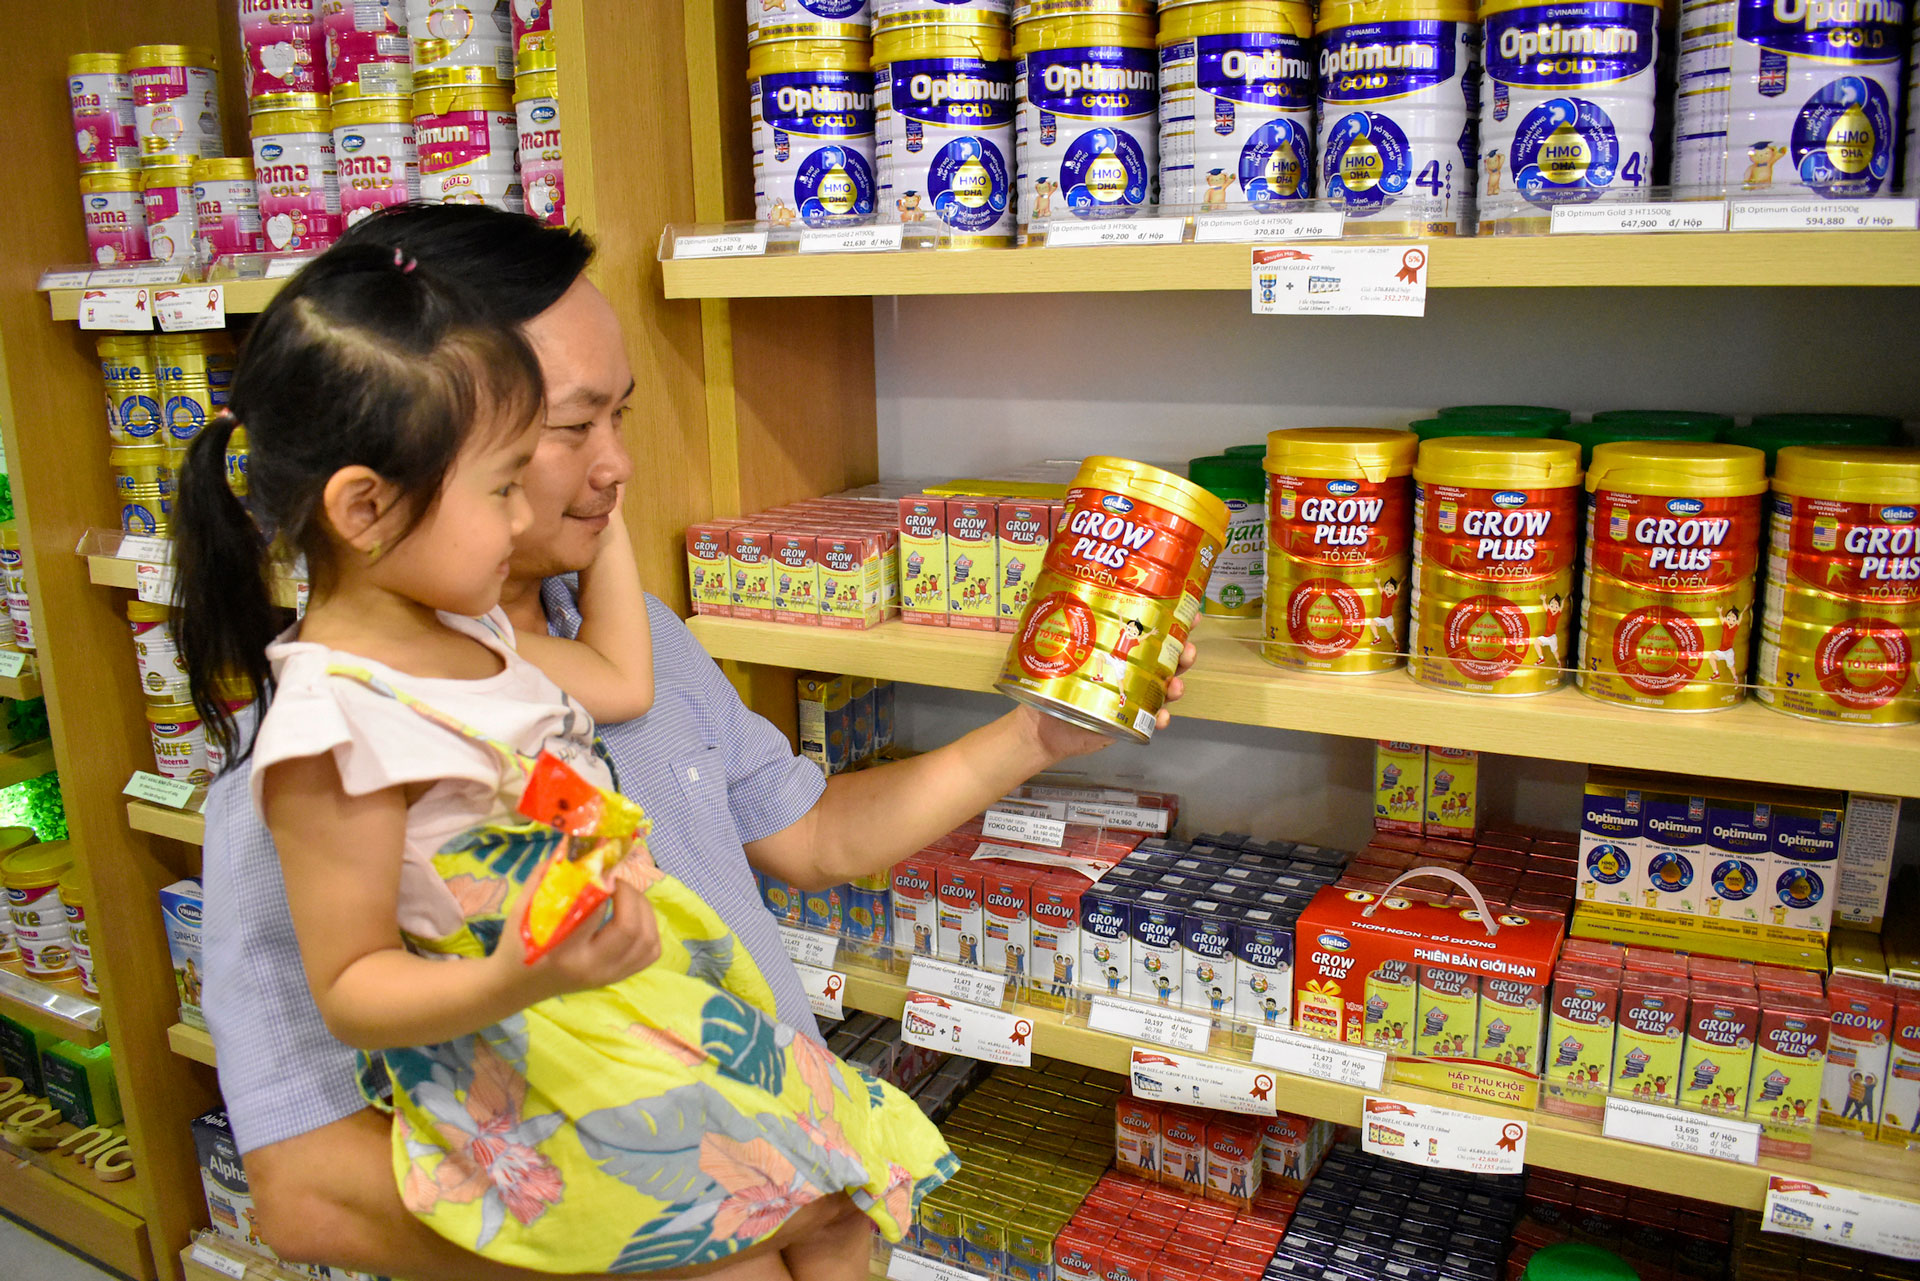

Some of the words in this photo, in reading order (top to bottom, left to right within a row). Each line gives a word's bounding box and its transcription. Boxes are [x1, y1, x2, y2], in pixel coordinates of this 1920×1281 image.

[1500, 24, 1638, 65] Optimum
[1319, 42, 1433, 76] Optimum
[1537, 59, 1597, 75] GOLD
[1340, 73, 1388, 91] GOLD
[1082, 94, 1130, 107] GOLD
[948, 103, 992, 117] GOLD
[812, 114, 856, 127] GOLD
[1837, 131, 1869, 144] HMO
[1546, 146, 1582, 158] HMO
[1841, 149, 1863, 158] DHA
[1345, 156, 1375, 168] HMO
[1551, 162, 1576, 171] DHA
[960, 176, 986, 186] HMO
[1092, 169, 1121, 179] HMO
[1350, 171, 1370, 179] DHA
[1416, 160, 1444, 196] 4
[352, 177, 393, 190] GOLD
[444, 175, 470, 189] GOLD
[824, 184, 851, 192] HMO
[270, 184, 311, 197] GOLD
[1568, 209, 1604, 219] Optimum
[1607, 208, 1626, 217] Gold
[1628, 208, 1633, 216] 3
[1635, 207, 1671, 218] HT1500g
[1750, 206, 1787, 216] Optimum
[1790, 205, 1810, 213] Gold
[1820, 205, 1859, 214] HT1500g
[1621, 219, 1658, 229] 647,900
[1683, 218, 1703, 229] Hộp
[1806, 216, 1845, 226] 594,880
[1872, 215, 1893, 226] Hộp
[1100, 233, 1130, 241] 409,200
[1149, 232, 1164, 241] Hộp
[1254, 227, 1285, 236] 370,810
[1306, 226, 1323, 236] Hộp
[712, 244, 733, 252] 426,140
[843, 239, 866, 247] 421,630
[880, 239, 893, 247] Hộp
[1408, 255, 1420, 263] 5%
[103, 362, 141, 381] Sure
[1301, 498, 1384, 523] GROW
[905, 515, 937, 528] GROW
[953, 517, 987, 530] GROW
[1006, 520, 1040, 533] GROW
[1463, 510, 1551, 536] GROW
[912, 525, 932, 536] PLUS
[959, 528, 982, 538] PLUS
[1011, 530, 1035, 542] PLUS
[1070, 510, 1155, 550] GROW
[1314, 524, 1368, 546] PLUS
[1634, 517, 1730, 546] GROW
[694, 542, 718, 552] GROW
[736, 545, 761, 555] GROW
[780, 548, 806, 559] GROW
[1071, 536, 1129, 569] PLUS
[1476, 538, 1535, 561] PLUS
[699, 550, 715, 559] PLUS
[741, 553, 758, 563] PLUS
[785, 556, 803, 566] PLUS
[825, 552, 853, 563] GROW
[1649, 548, 1712, 571] PLUS
[831, 560, 848, 570] PLUS
[152, 737, 192, 756] Sure
[1587, 811, 1638, 827] Optimum
[988, 822, 1005, 833] YOKO
[1007, 824, 1025, 833] GOLD
[1649, 819, 1702, 834] Optimum
[1713, 826, 1767, 842] Optimum
[1779, 833, 1833, 848] Optimum
[895, 876, 930, 891] GROW
[941, 884, 976, 900] GROW
[987, 894, 1023, 910] GROW
[1035, 902, 1074, 919] GROW
[1088, 913, 1123, 928] GROW
[1093, 923, 1118, 936] PLUS
[1139, 922, 1176, 936] GROW
[1351, 921, 1385, 932] THƠM
[1387, 927, 1421, 938] NGON
[1431, 934, 1449, 942] BỔ
[1450, 937, 1496, 949] DƯỠNG
[1145, 933, 1170, 946] PLUS
[1191, 931, 1229, 947] GROW
[1198, 943, 1223, 956] PLUS
[1245, 942, 1283, 958] GROW
[1251, 953, 1277, 966] PLUS
[1311, 952, 1355, 970] GROW
[1414, 948, 1450, 963] PHIÊN
[1451, 953, 1478, 967] BẢN
[1480, 959, 1506, 971] GIỚI
[1508, 964, 1536, 978] HẠN
[1318, 965, 1347, 980] PLUS
[1427, 968, 1468, 985] GROW
[953, 978, 971, 986] 11,473
[1433, 980, 1460, 994] PLUS
[1489, 979, 1533, 995] GROW
[1496, 990, 1525, 1004] PLUS
[1561, 996, 1605, 1013] GROW
[1568, 1008, 1597, 1022] PLUS
[1628, 1007, 1675, 1023] GROW
[1831, 1011, 1884, 1031] GROW
[1144, 1018, 1163, 1027] 10,197
[1635, 1019, 1665, 1033] PLUS
[1698, 1017, 1745, 1036] GROW
[1705, 1030, 1736, 1045] PLUS
[1768, 1028, 1817, 1046] GROW
[1775, 1040, 1808, 1055] PLUS
[1312, 1053, 1333, 1063] 11,473
[1352, 1062, 1366, 1070] Hộp
[1448, 1071, 1470, 1081] HẤP
[1473, 1076, 1493, 1087] THU
[1496, 1079, 1525, 1092] KHỎE
[1452, 1081, 1465, 1090] BÉ
[1467, 1083, 1496, 1096] TĂNG
[1498, 1090, 1520, 1101] CÂN
[201, 1113, 226, 1128] Alpha
[1122, 1115, 1150, 1129] GROW
[1167, 1128, 1196, 1142] GROW
[1267, 1125, 1296, 1138] GROW
[1674, 1125, 1699, 1135] 13,695
[1721, 1133, 1737, 1143] Hộp
[1671, 1141, 1698, 1151] 657,360
[1676, 1133, 1699, 1143] 54,780
[1720, 1141, 1732, 1150] lốc
[1214, 1142, 1243, 1156] GROW
[209, 1154, 247, 1183] Alpha
[1061, 1256, 1092, 1271] GROW
